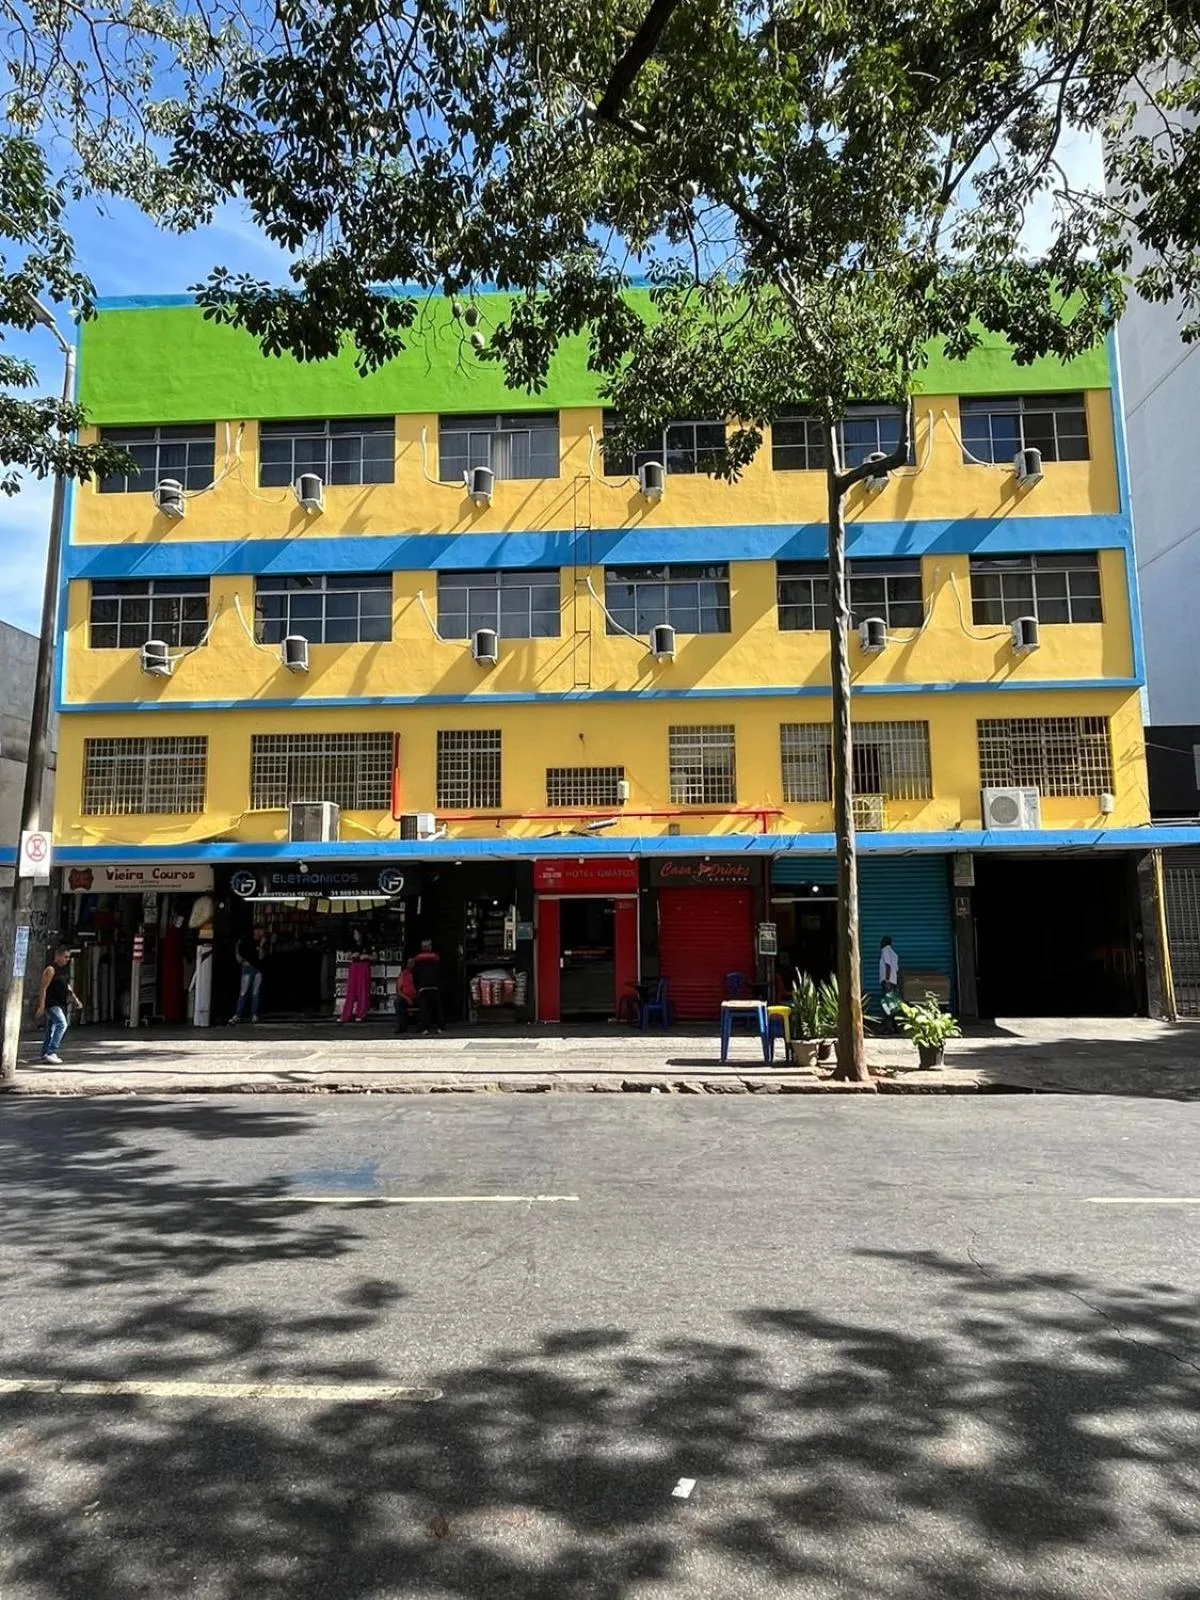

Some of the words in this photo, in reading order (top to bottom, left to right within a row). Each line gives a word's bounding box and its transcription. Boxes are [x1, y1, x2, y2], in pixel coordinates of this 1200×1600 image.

[106, 868, 144, 881] Vieira
[152, 867, 196, 880] Couros
[565, 869, 595, 878] HOTEL
[660, 862, 692, 877] Casa
[708, 863, 750, 877] Drinks
